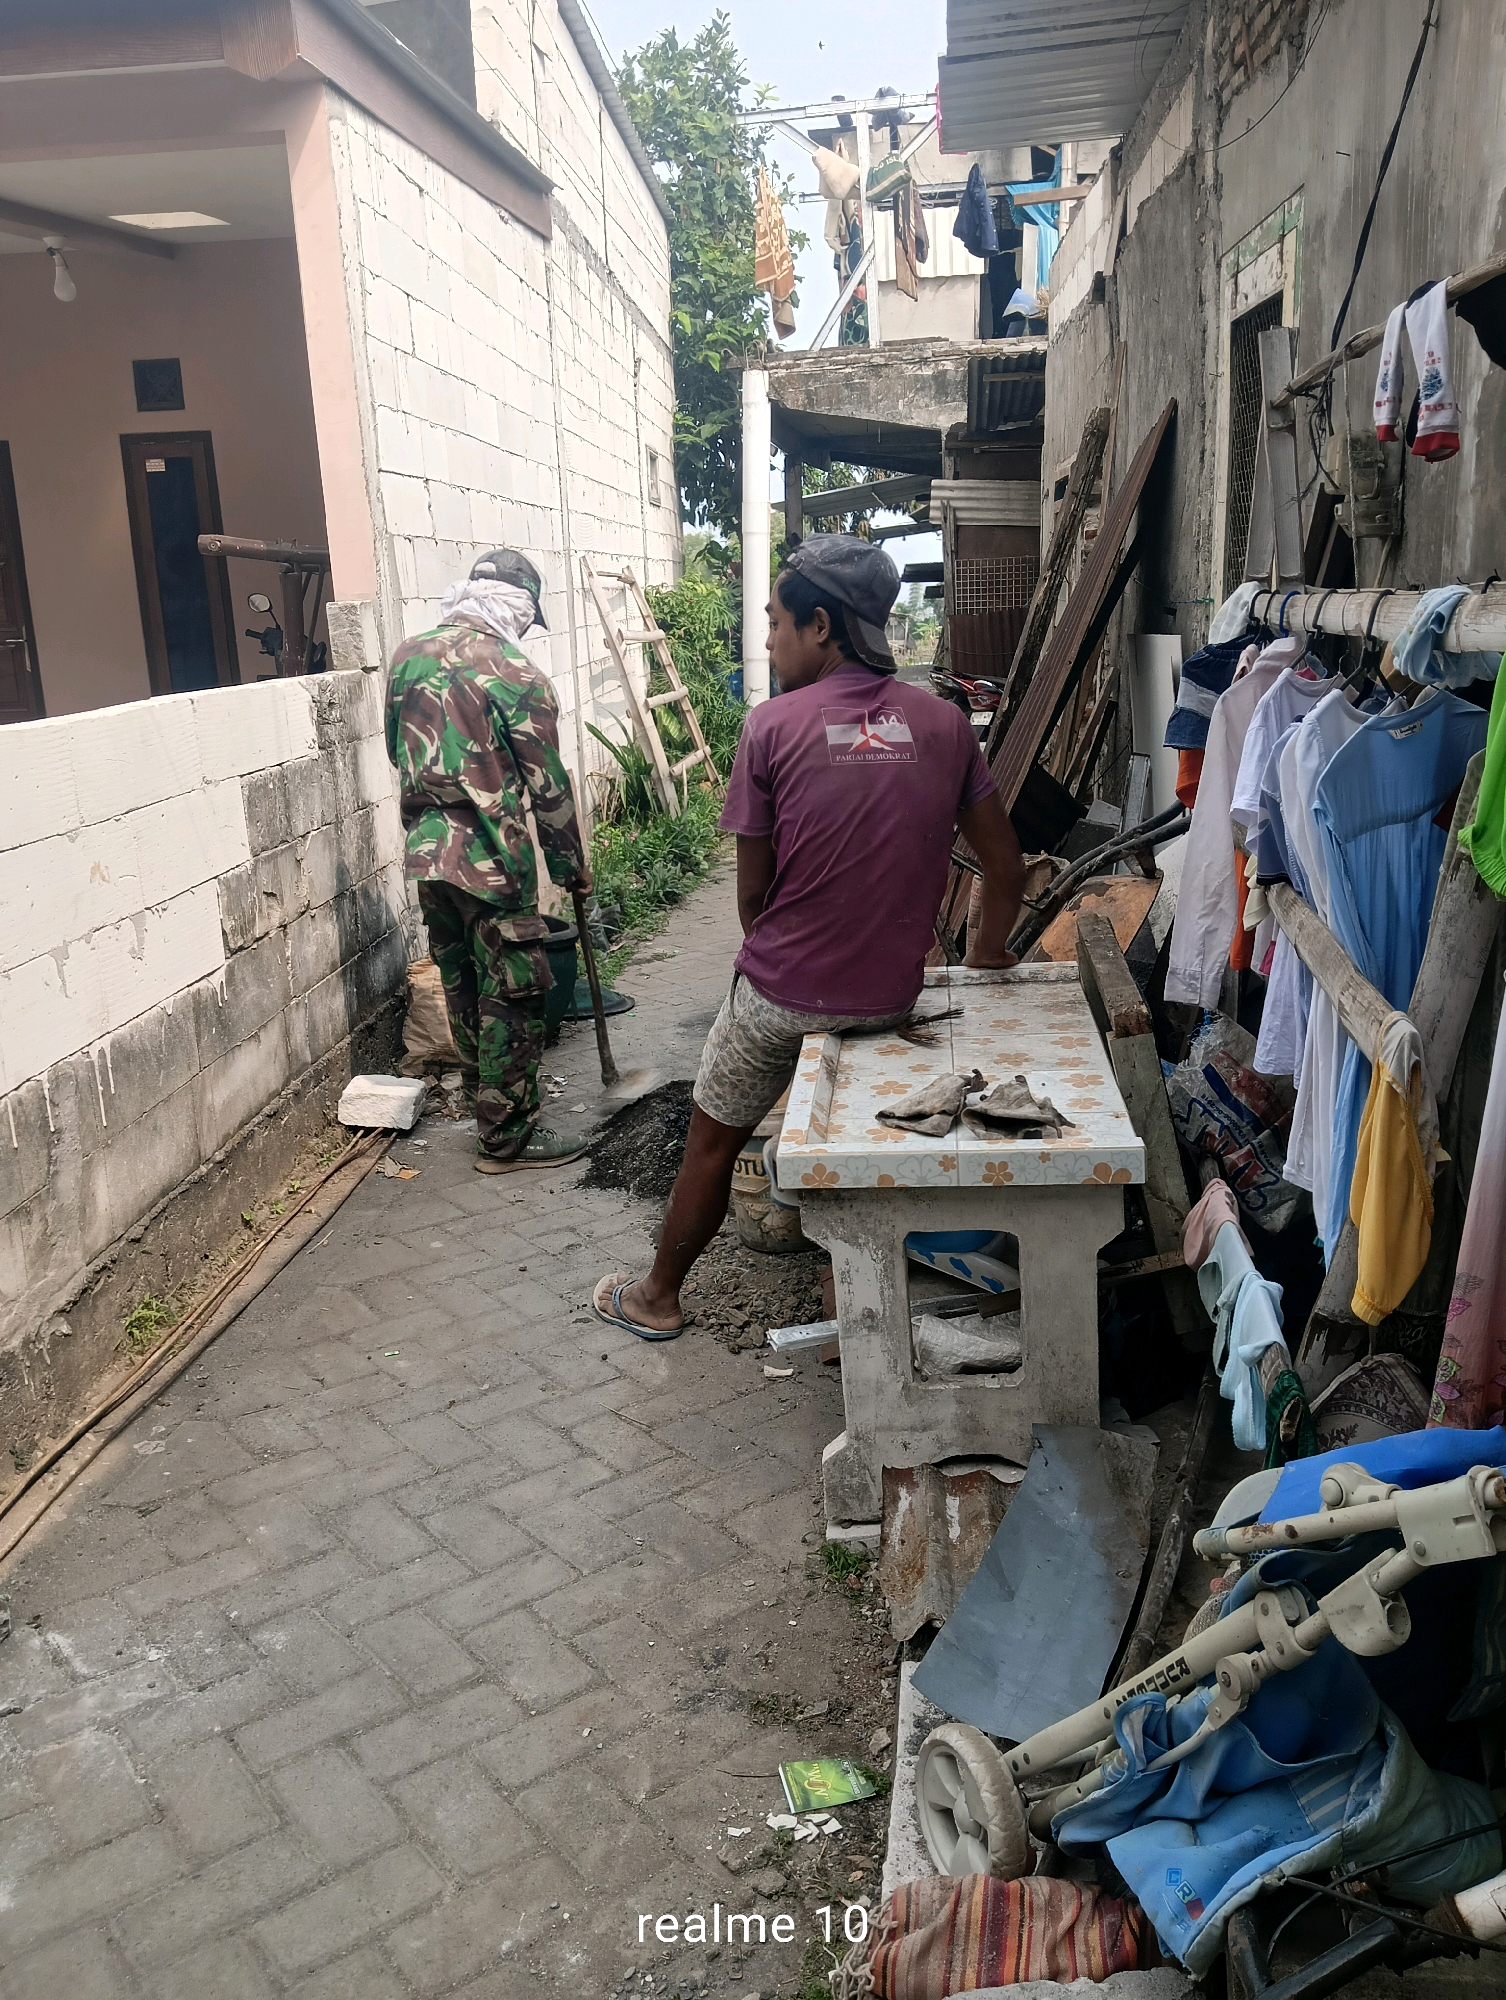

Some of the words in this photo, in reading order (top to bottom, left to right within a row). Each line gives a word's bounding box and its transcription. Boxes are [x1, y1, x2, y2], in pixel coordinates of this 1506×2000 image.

[878, 714, 900, 728] 14
[835, 754, 864, 762] PARTAI
[865, 752, 911, 761] DEMOKRAT
